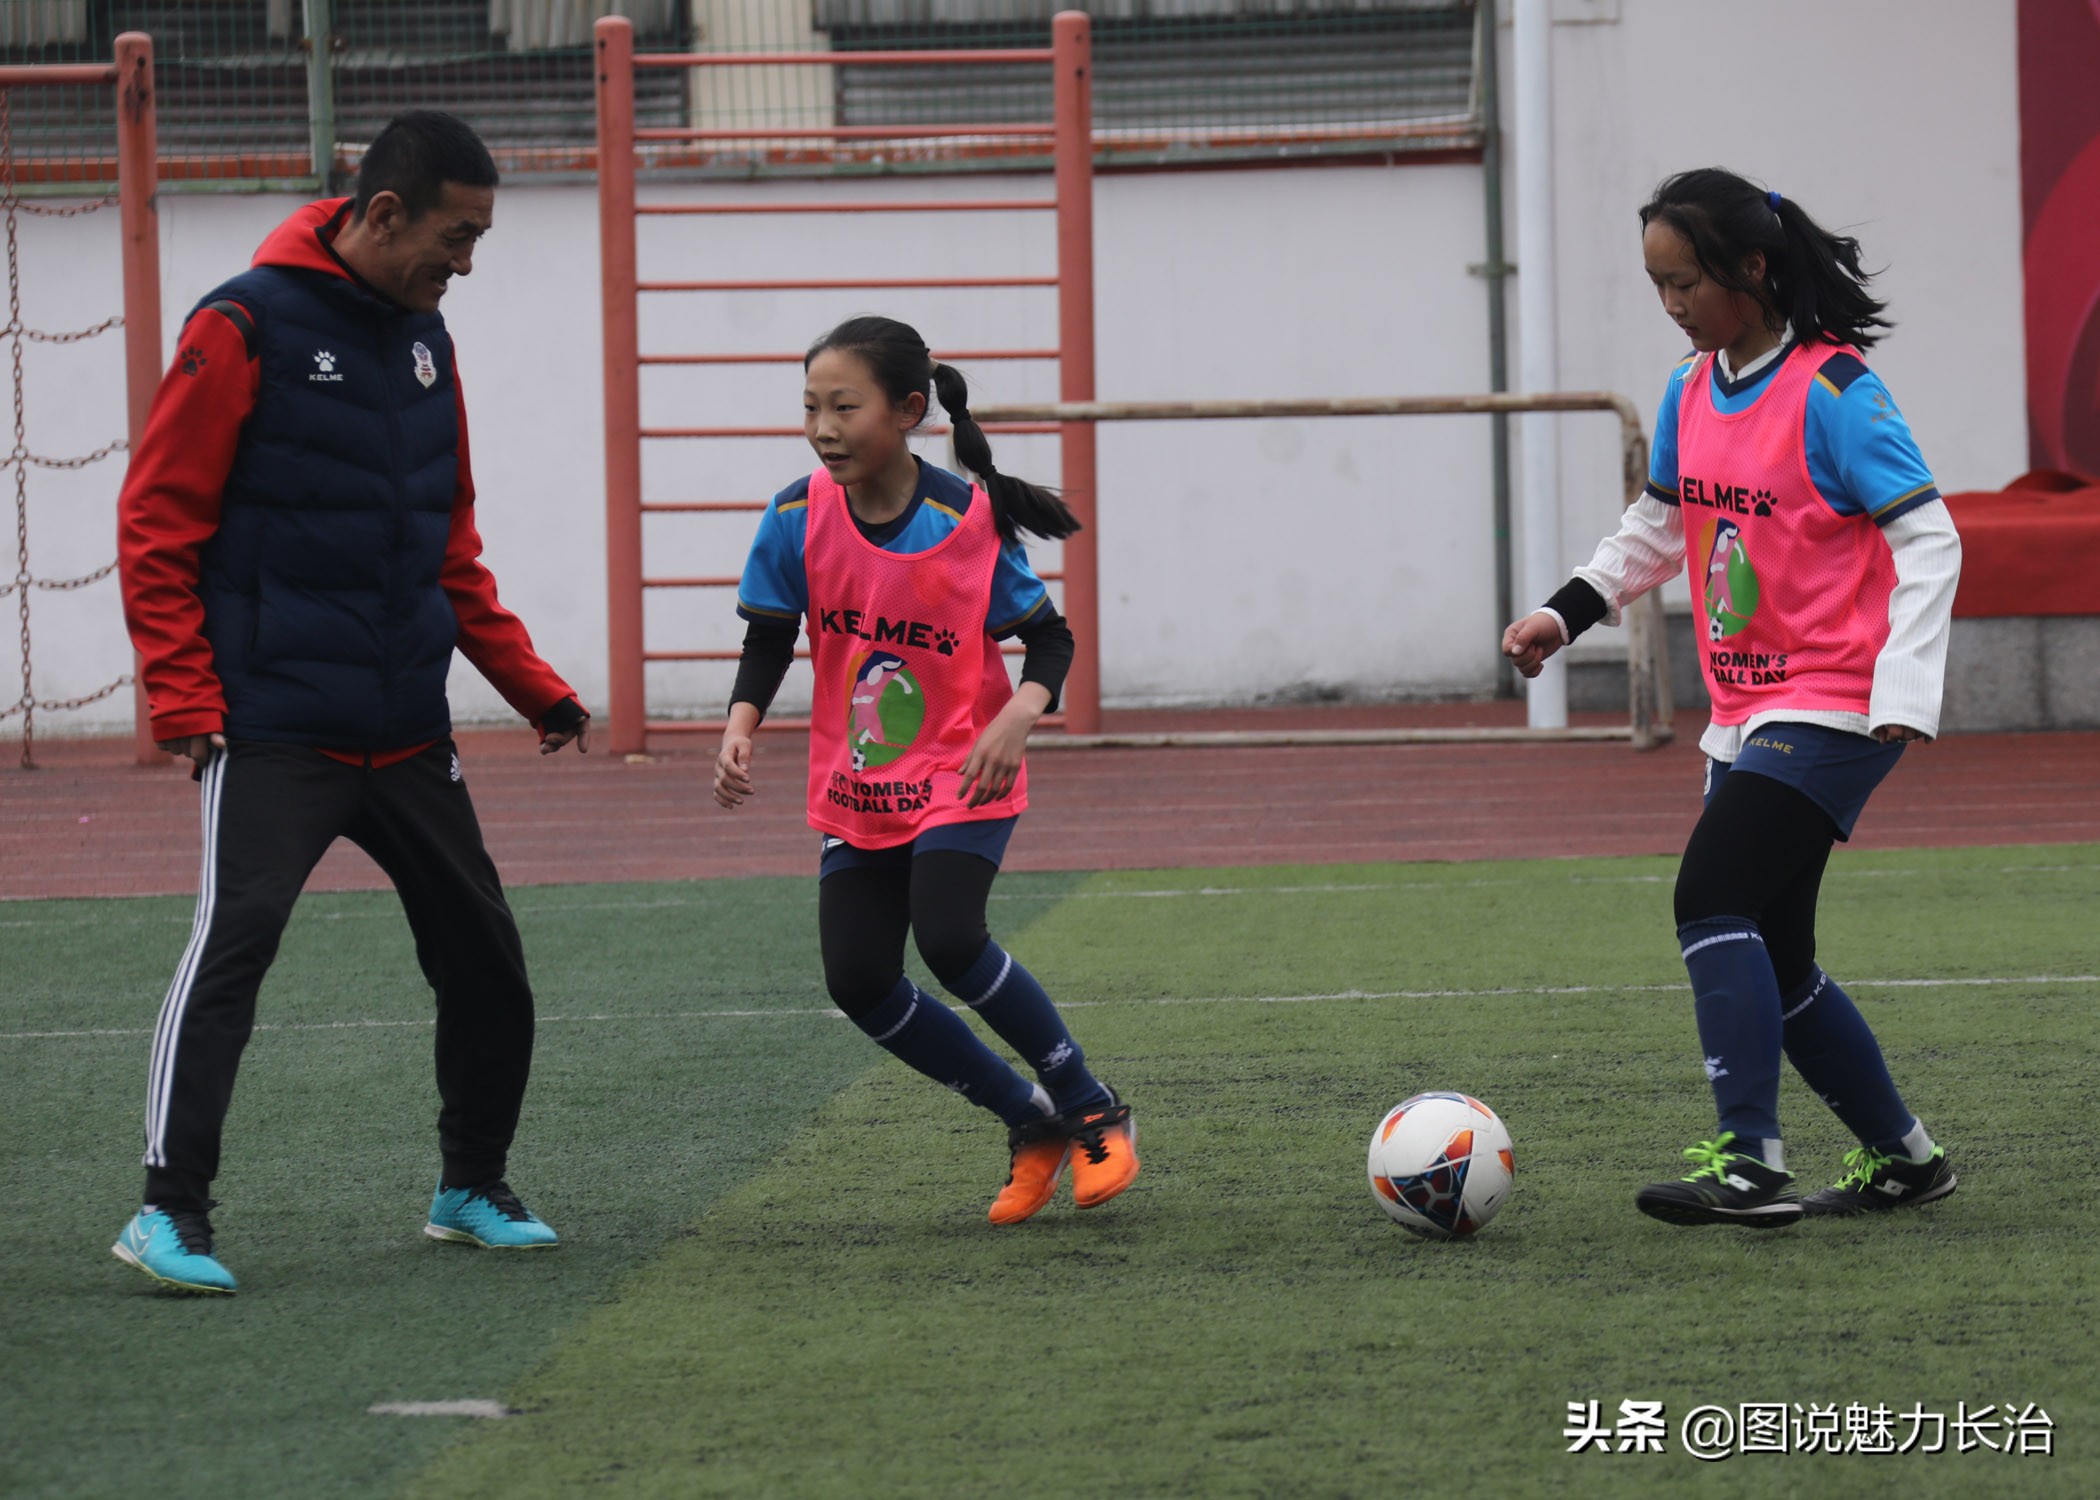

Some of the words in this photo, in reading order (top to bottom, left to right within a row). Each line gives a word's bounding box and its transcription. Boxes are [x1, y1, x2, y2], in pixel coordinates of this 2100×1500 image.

[309, 373, 343, 381] KELME
[1679, 475, 1749, 515] ELME
[820, 608, 933, 649] KELME
[1752, 670, 1786, 685] DAY
[1749, 738, 1794, 755] KELME
[898, 793, 932, 812] DAY
